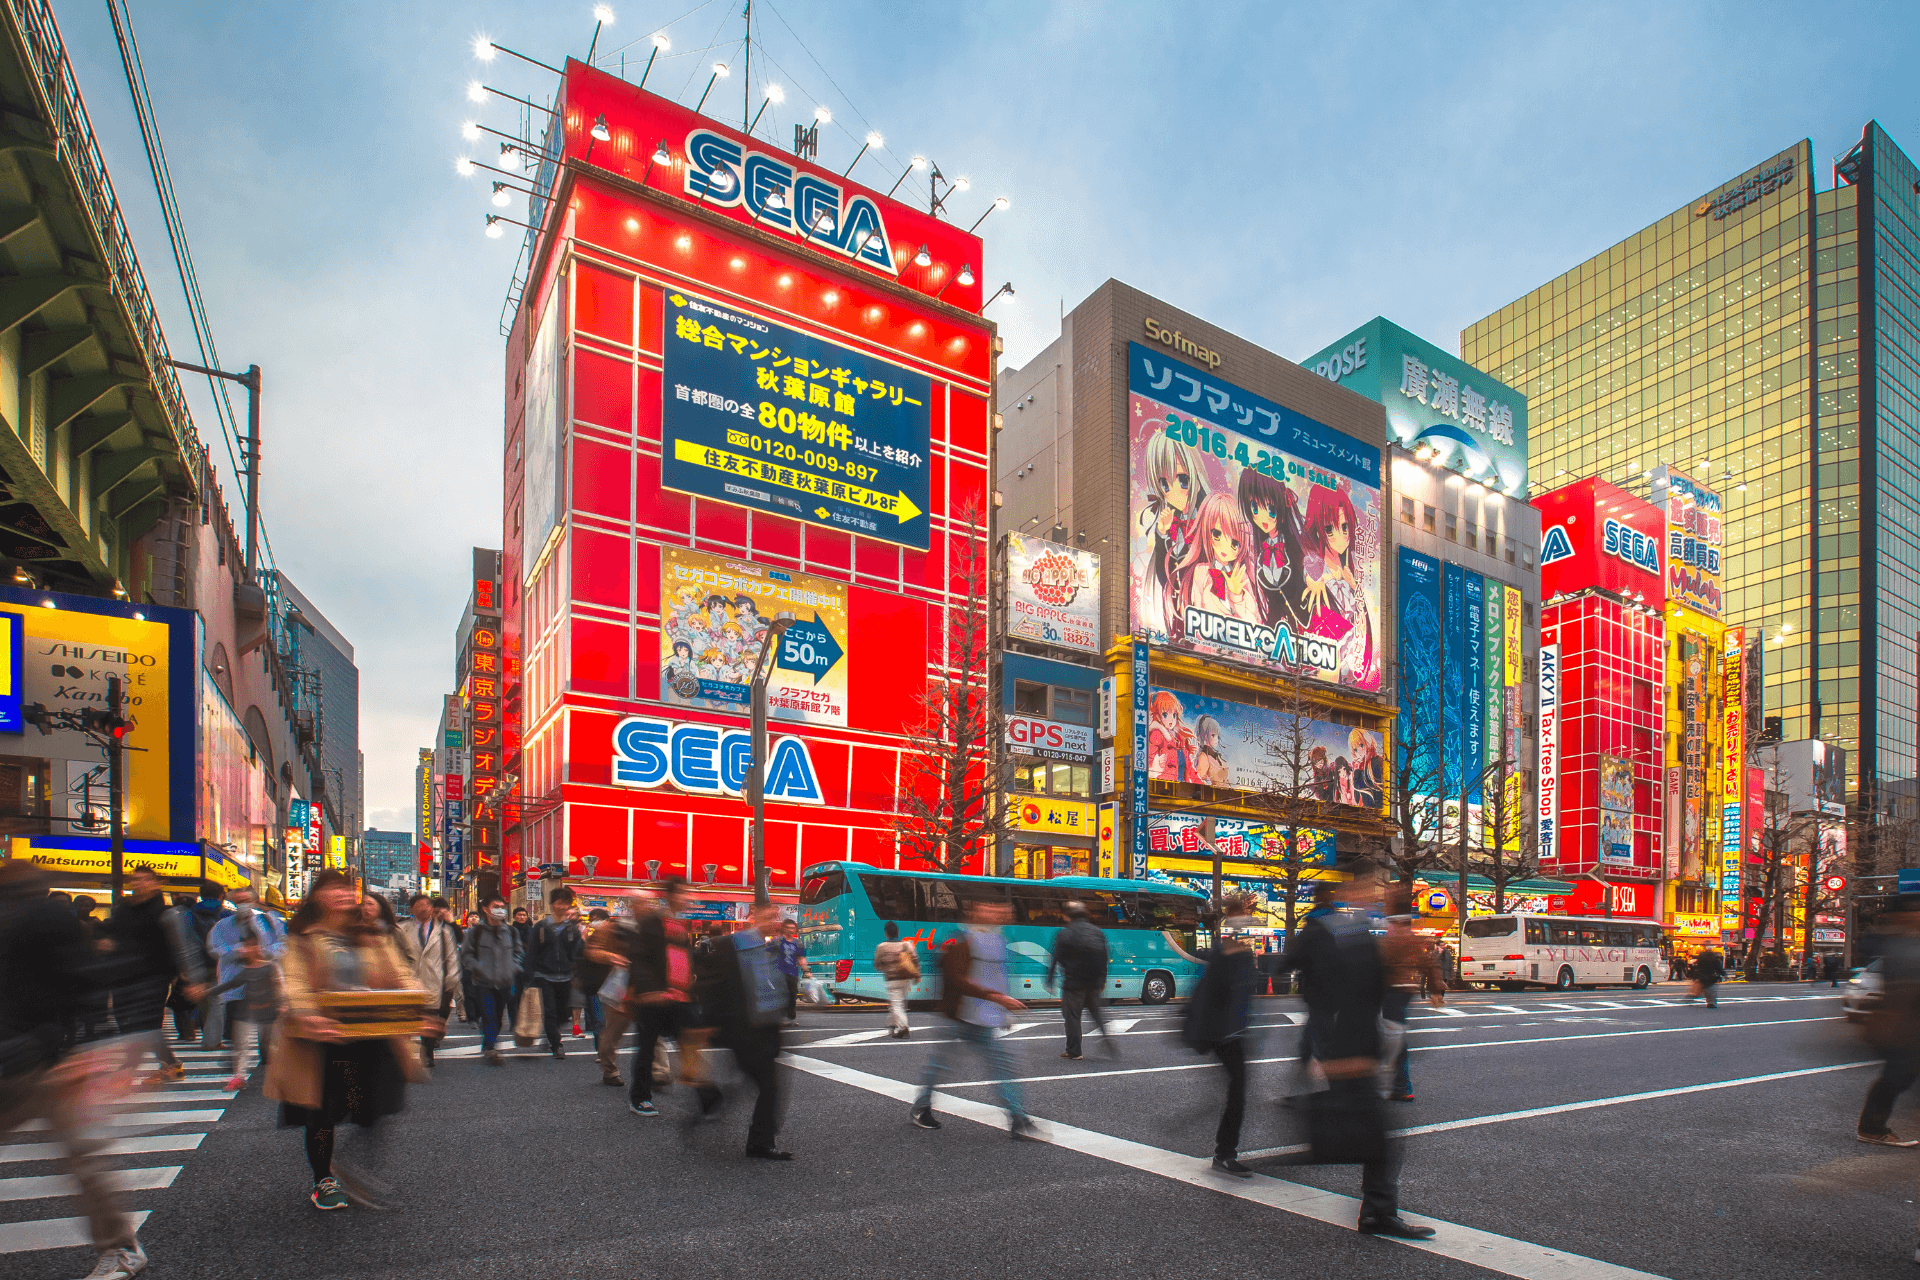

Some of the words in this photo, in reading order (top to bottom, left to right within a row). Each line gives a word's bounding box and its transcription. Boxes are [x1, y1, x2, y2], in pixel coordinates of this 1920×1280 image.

[684, 128, 898, 276] SEGA
[689, 300, 769, 333] 住友不動産のマンション
[1145, 317, 1222, 371] Sofmap
[1311, 336, 1367, 382] POSE
[676, 315, 922, 407] 総合マンションギャラリー
[756, 366, 856, 417] 秋葉原館
[1143, 357, 1281, 436] ソフマップ
[1292, 427, 1371, 471] アミューズメント館
[750, 436, 878, 483] 0120-009-897
[703, 448, 898, 511] 住友不動産秋葉原ビル8F
[1288, 461, 1306, 479] ON
[1308, 470, 1337, 491] SALE
[832, 511, 878, 531] 住友不動産
[1602, 517, 1660, 576] SEGA
[1669, 530, 1721, 576] 高額買取
[1022, 568, 1041, 585] BIG
[1043, 567, 1090, 588] APPLE
[1411, 558, 1428, 572] Hey
[672, 564, 842, 611] セガコラボカフェ開催中!!
[1669, 564, 1722, 611] Mulan
[1015, 600, 1035, 615] BIG
[38, 643, 156, 667] SHISEIDO
[784, 641, 829, 667] 50m
[90, 669, 146, 686] KOSÉ
[1135, 659, 1147, 706] 売るのも
[1541, 650, 1555, 692] AKKY
[779, 686, 830, 703] クラブセガ
[1468, 604, 1481, 771] 電子マネー使えます!
[769, 695, 821, 714] 秋葉原新館
[823, 704, 841, 717] 7階
[1009, 719, 1064, 748] GPS
[1064, 741, 1087, 752] next
[1135, 723, 1146, 770] 買うのも
[1541, 709, 1555, 775] Tax-free
[612, 717, 825, 805] SEGA
[1043, 750, 1087, 763] 0120-915-047
[422, 767, 430, 810] PACHINKO
[1540, 778, 1555, 817] Shop
[1669, 771, 1678, 795] GAME
[1048, 809, 1078, 827] 松屋
[1134, 786, 1146, 851] サポートも
[309, 827, 320, 853] KFC
[31, 854, 112, 869] Matsumot
[1102, 848, 1111, 878] 松屋
[1134, 855, 1145, 880] ソフ
[1619, 886, 1636, 912] SEGA
[1830, 879, 1842, 888] 50
[1546, 947, 1627, 963] YUNAGI
